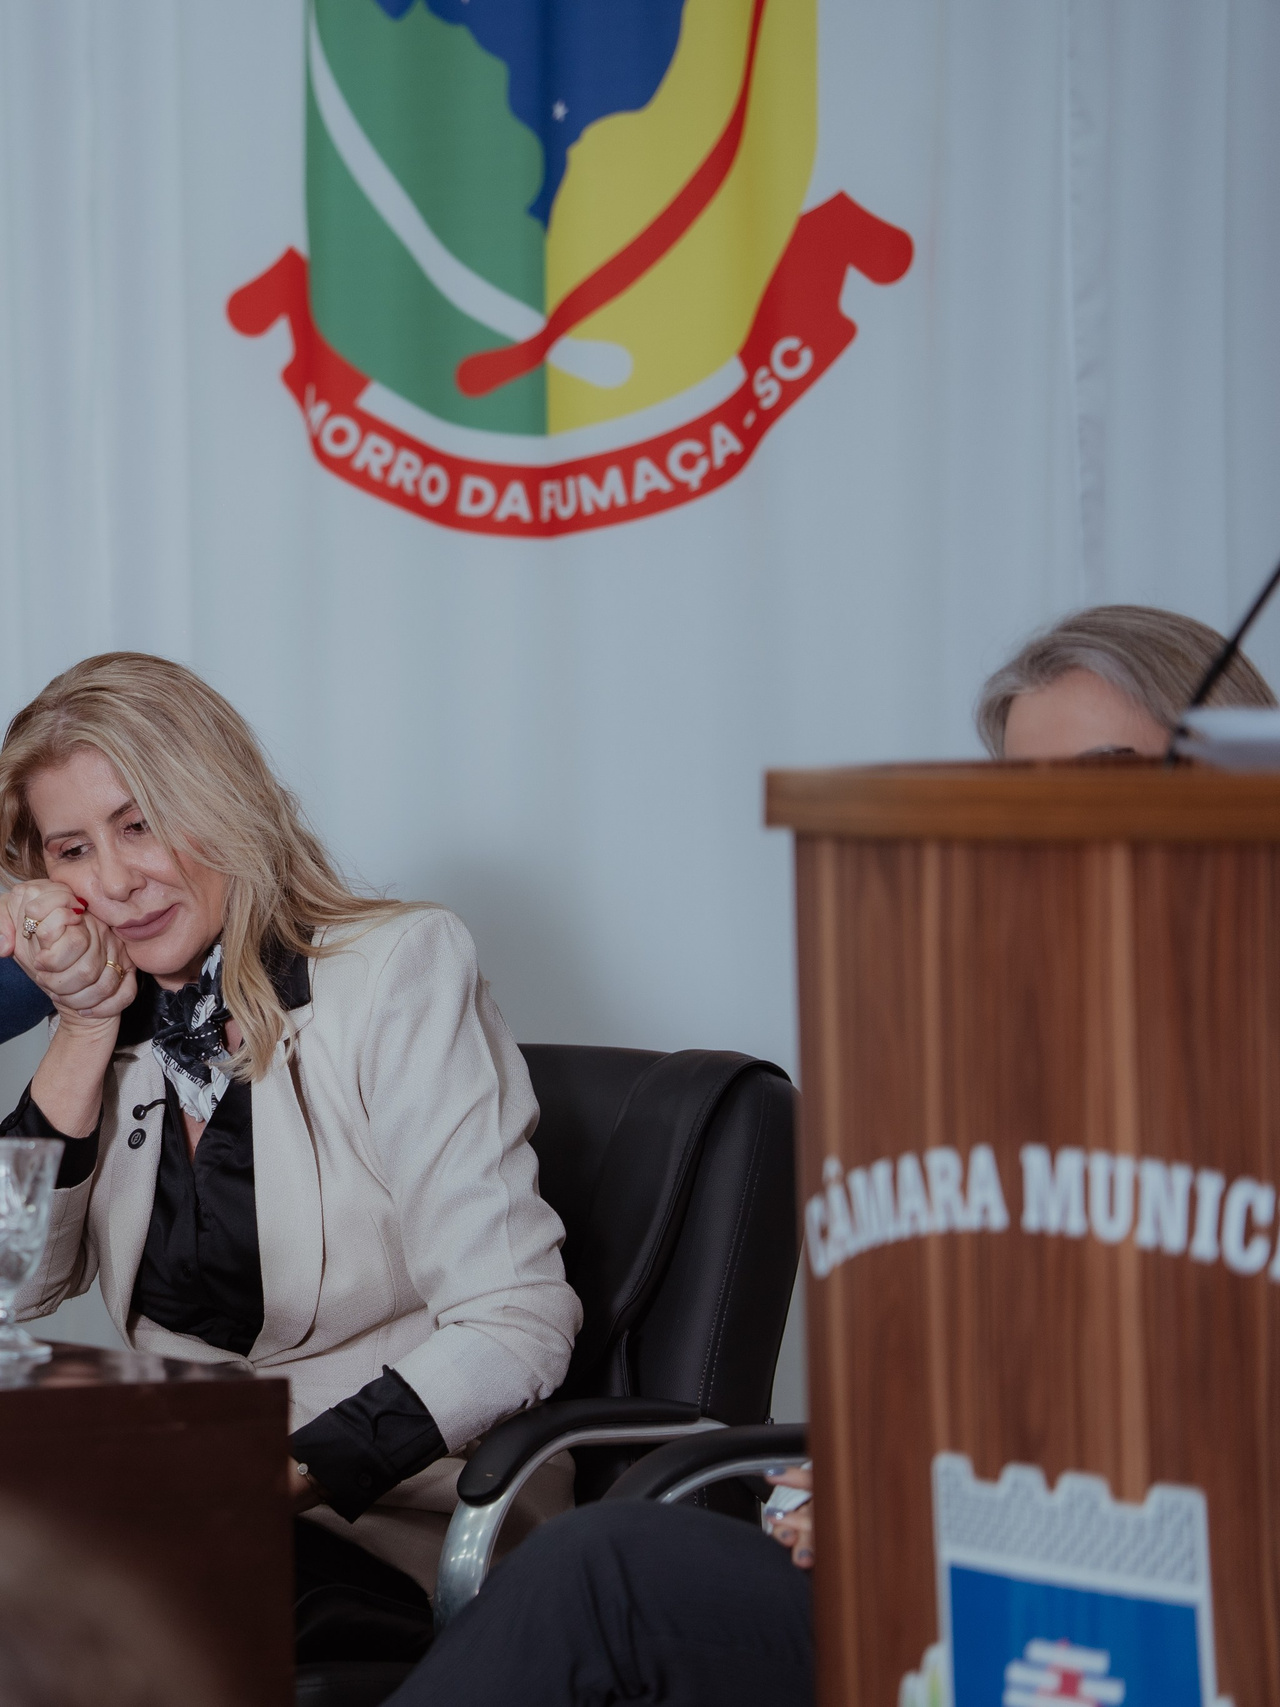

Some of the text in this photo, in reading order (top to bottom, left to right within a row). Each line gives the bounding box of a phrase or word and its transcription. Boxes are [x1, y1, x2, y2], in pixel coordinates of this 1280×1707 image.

[457, 474, 534, 522] DA
[539, 423, 742, 523] FUMAÇA
[752, 336, 814, 410] SC
[804, 1143, 1010, 1279] CÂMARA
